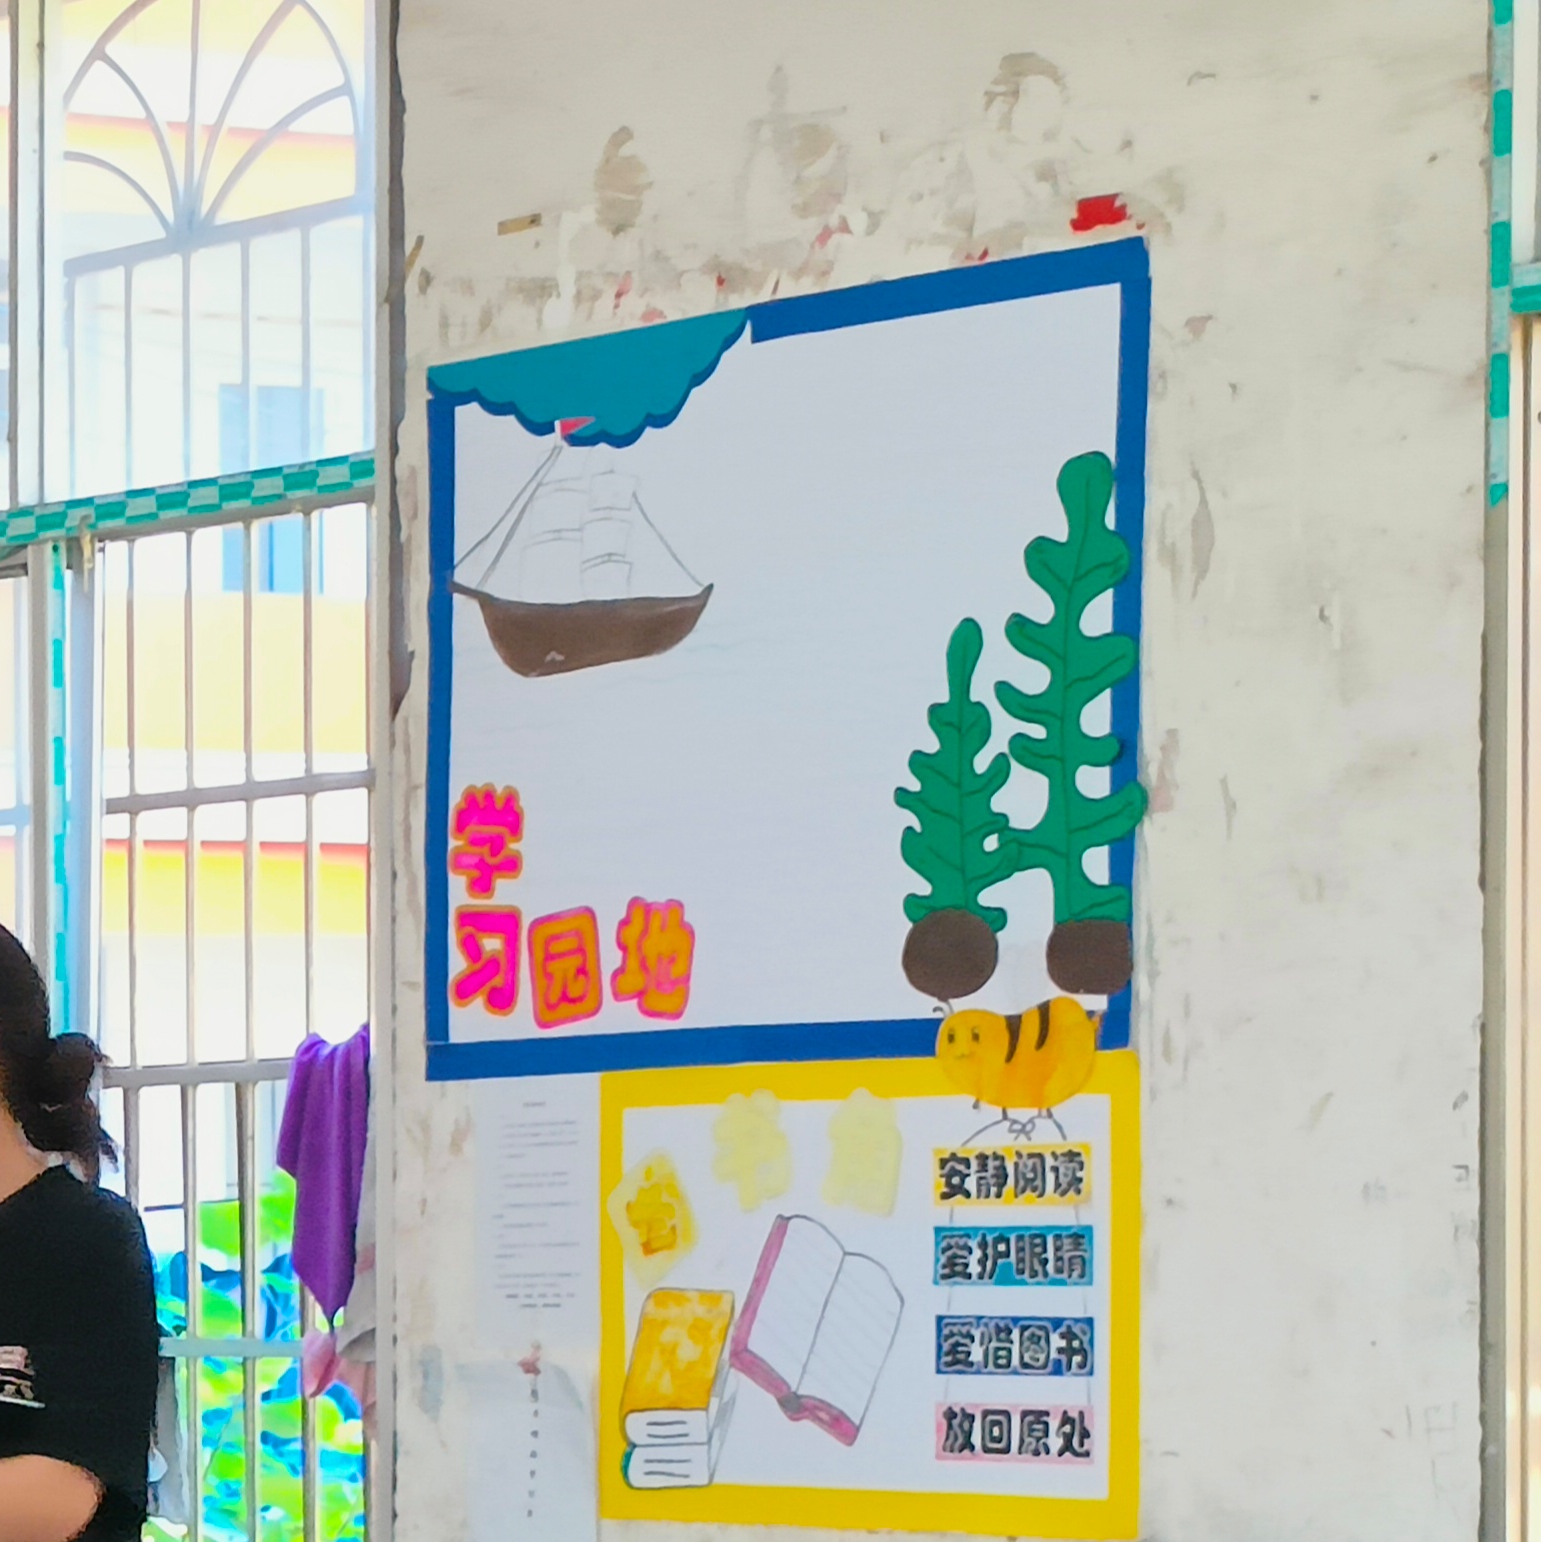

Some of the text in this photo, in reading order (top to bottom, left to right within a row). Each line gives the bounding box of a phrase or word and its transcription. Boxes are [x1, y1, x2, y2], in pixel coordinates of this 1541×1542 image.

[938, 1149, 1086, 1201] 安静阅读
[939, 1232, 1090, 1282] 爱护眼睛
[940, 1322, 1092, 1371] 爱惜图书
[941, 1406, 1092, 1459] 放回原处
